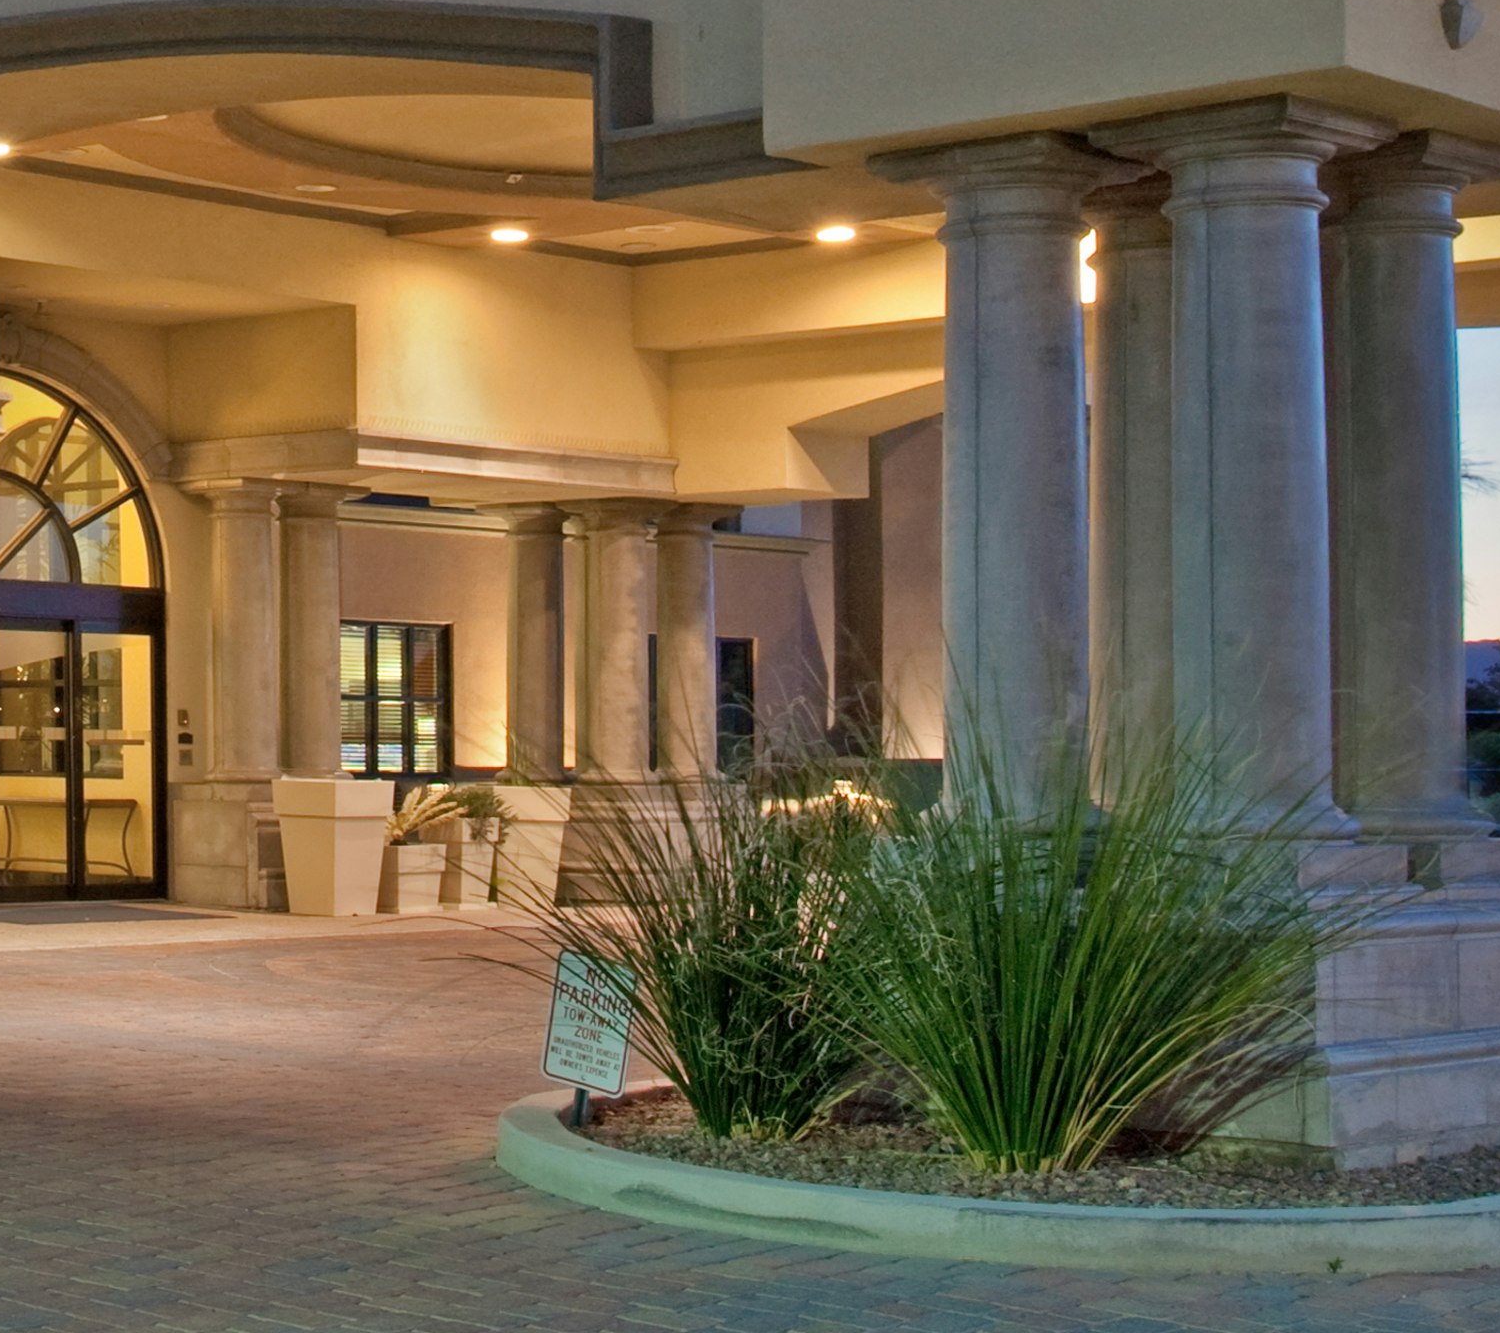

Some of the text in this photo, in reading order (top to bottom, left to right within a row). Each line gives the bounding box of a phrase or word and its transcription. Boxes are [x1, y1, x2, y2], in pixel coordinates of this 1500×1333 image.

[586, 966, 609, 990] NO
[559, 981, 630, 1018] PARKING
[563, 1005, 620, 1032] TOW-AWAY
[573, 1024, 603, 1045] ZONE
